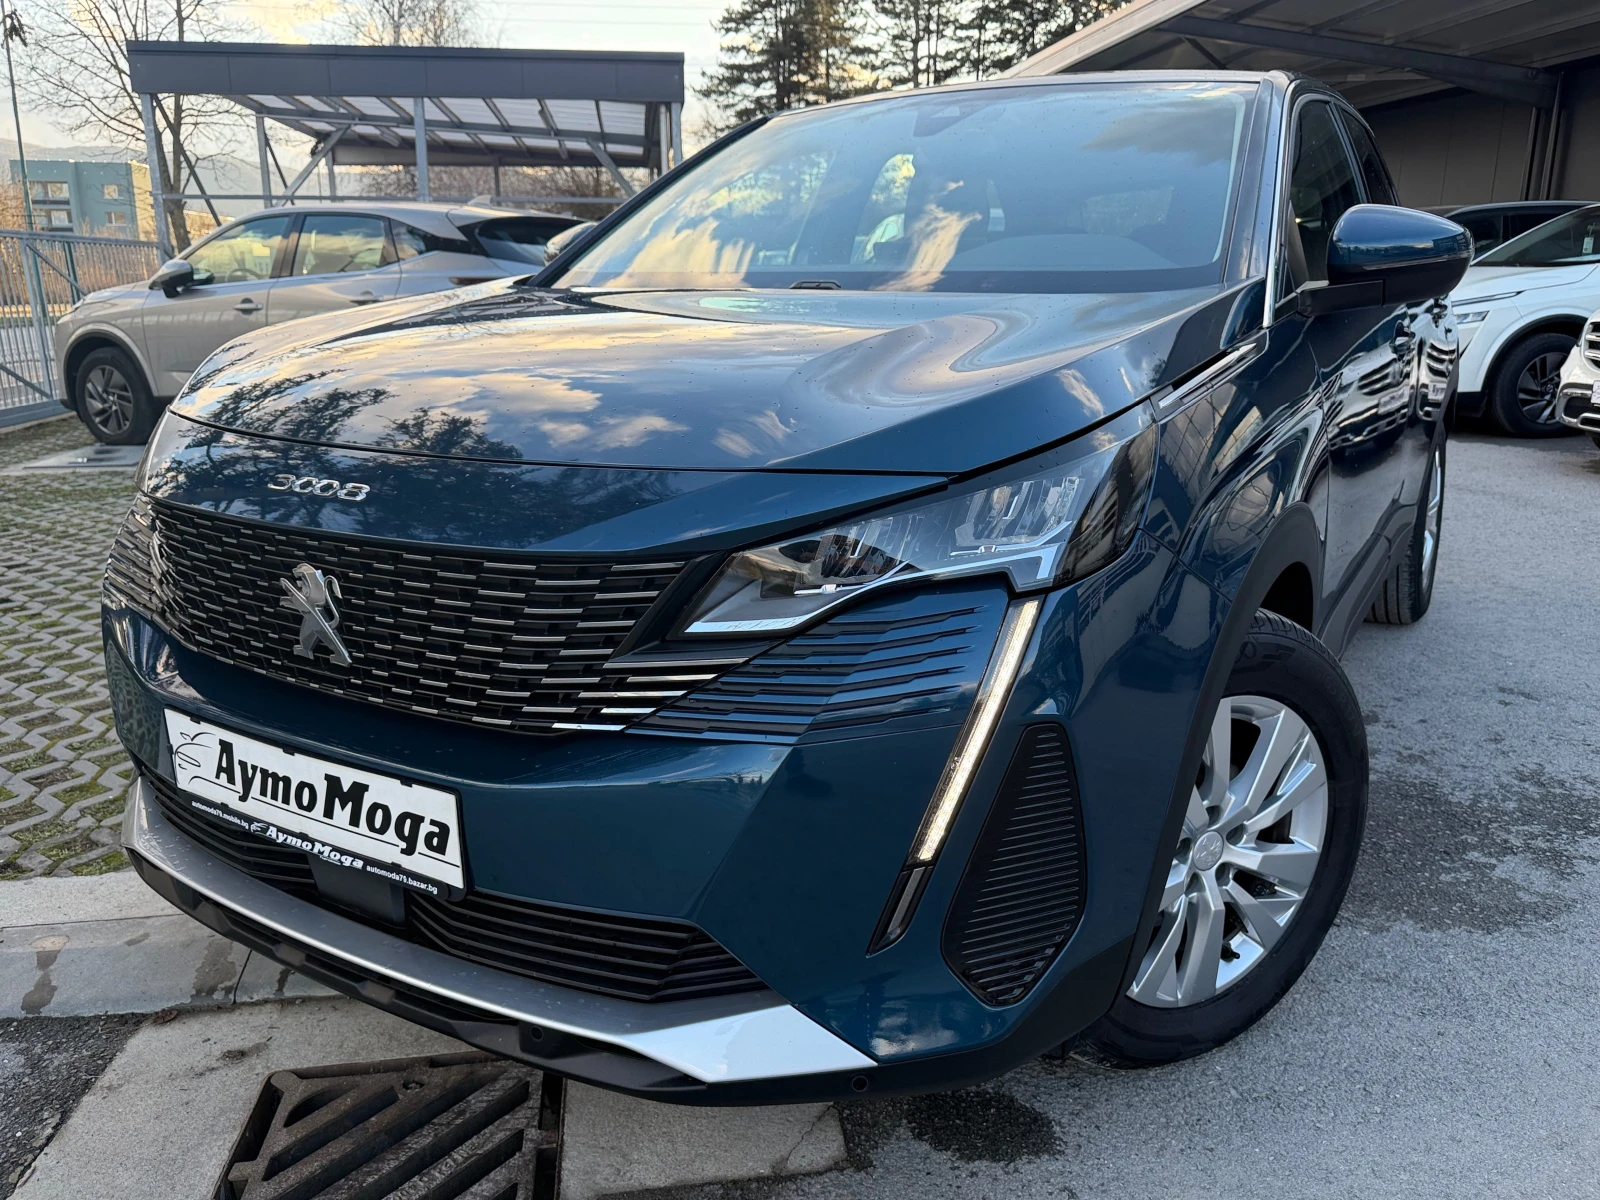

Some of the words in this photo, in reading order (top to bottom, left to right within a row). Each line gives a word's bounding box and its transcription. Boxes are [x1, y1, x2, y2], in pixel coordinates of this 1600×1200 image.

[267, 473, 371, 501] 3008
[191, 801, 249, 830] automoda79.mobile.bg
[366, 864, 438, 895] automoda79.bazar.bg
